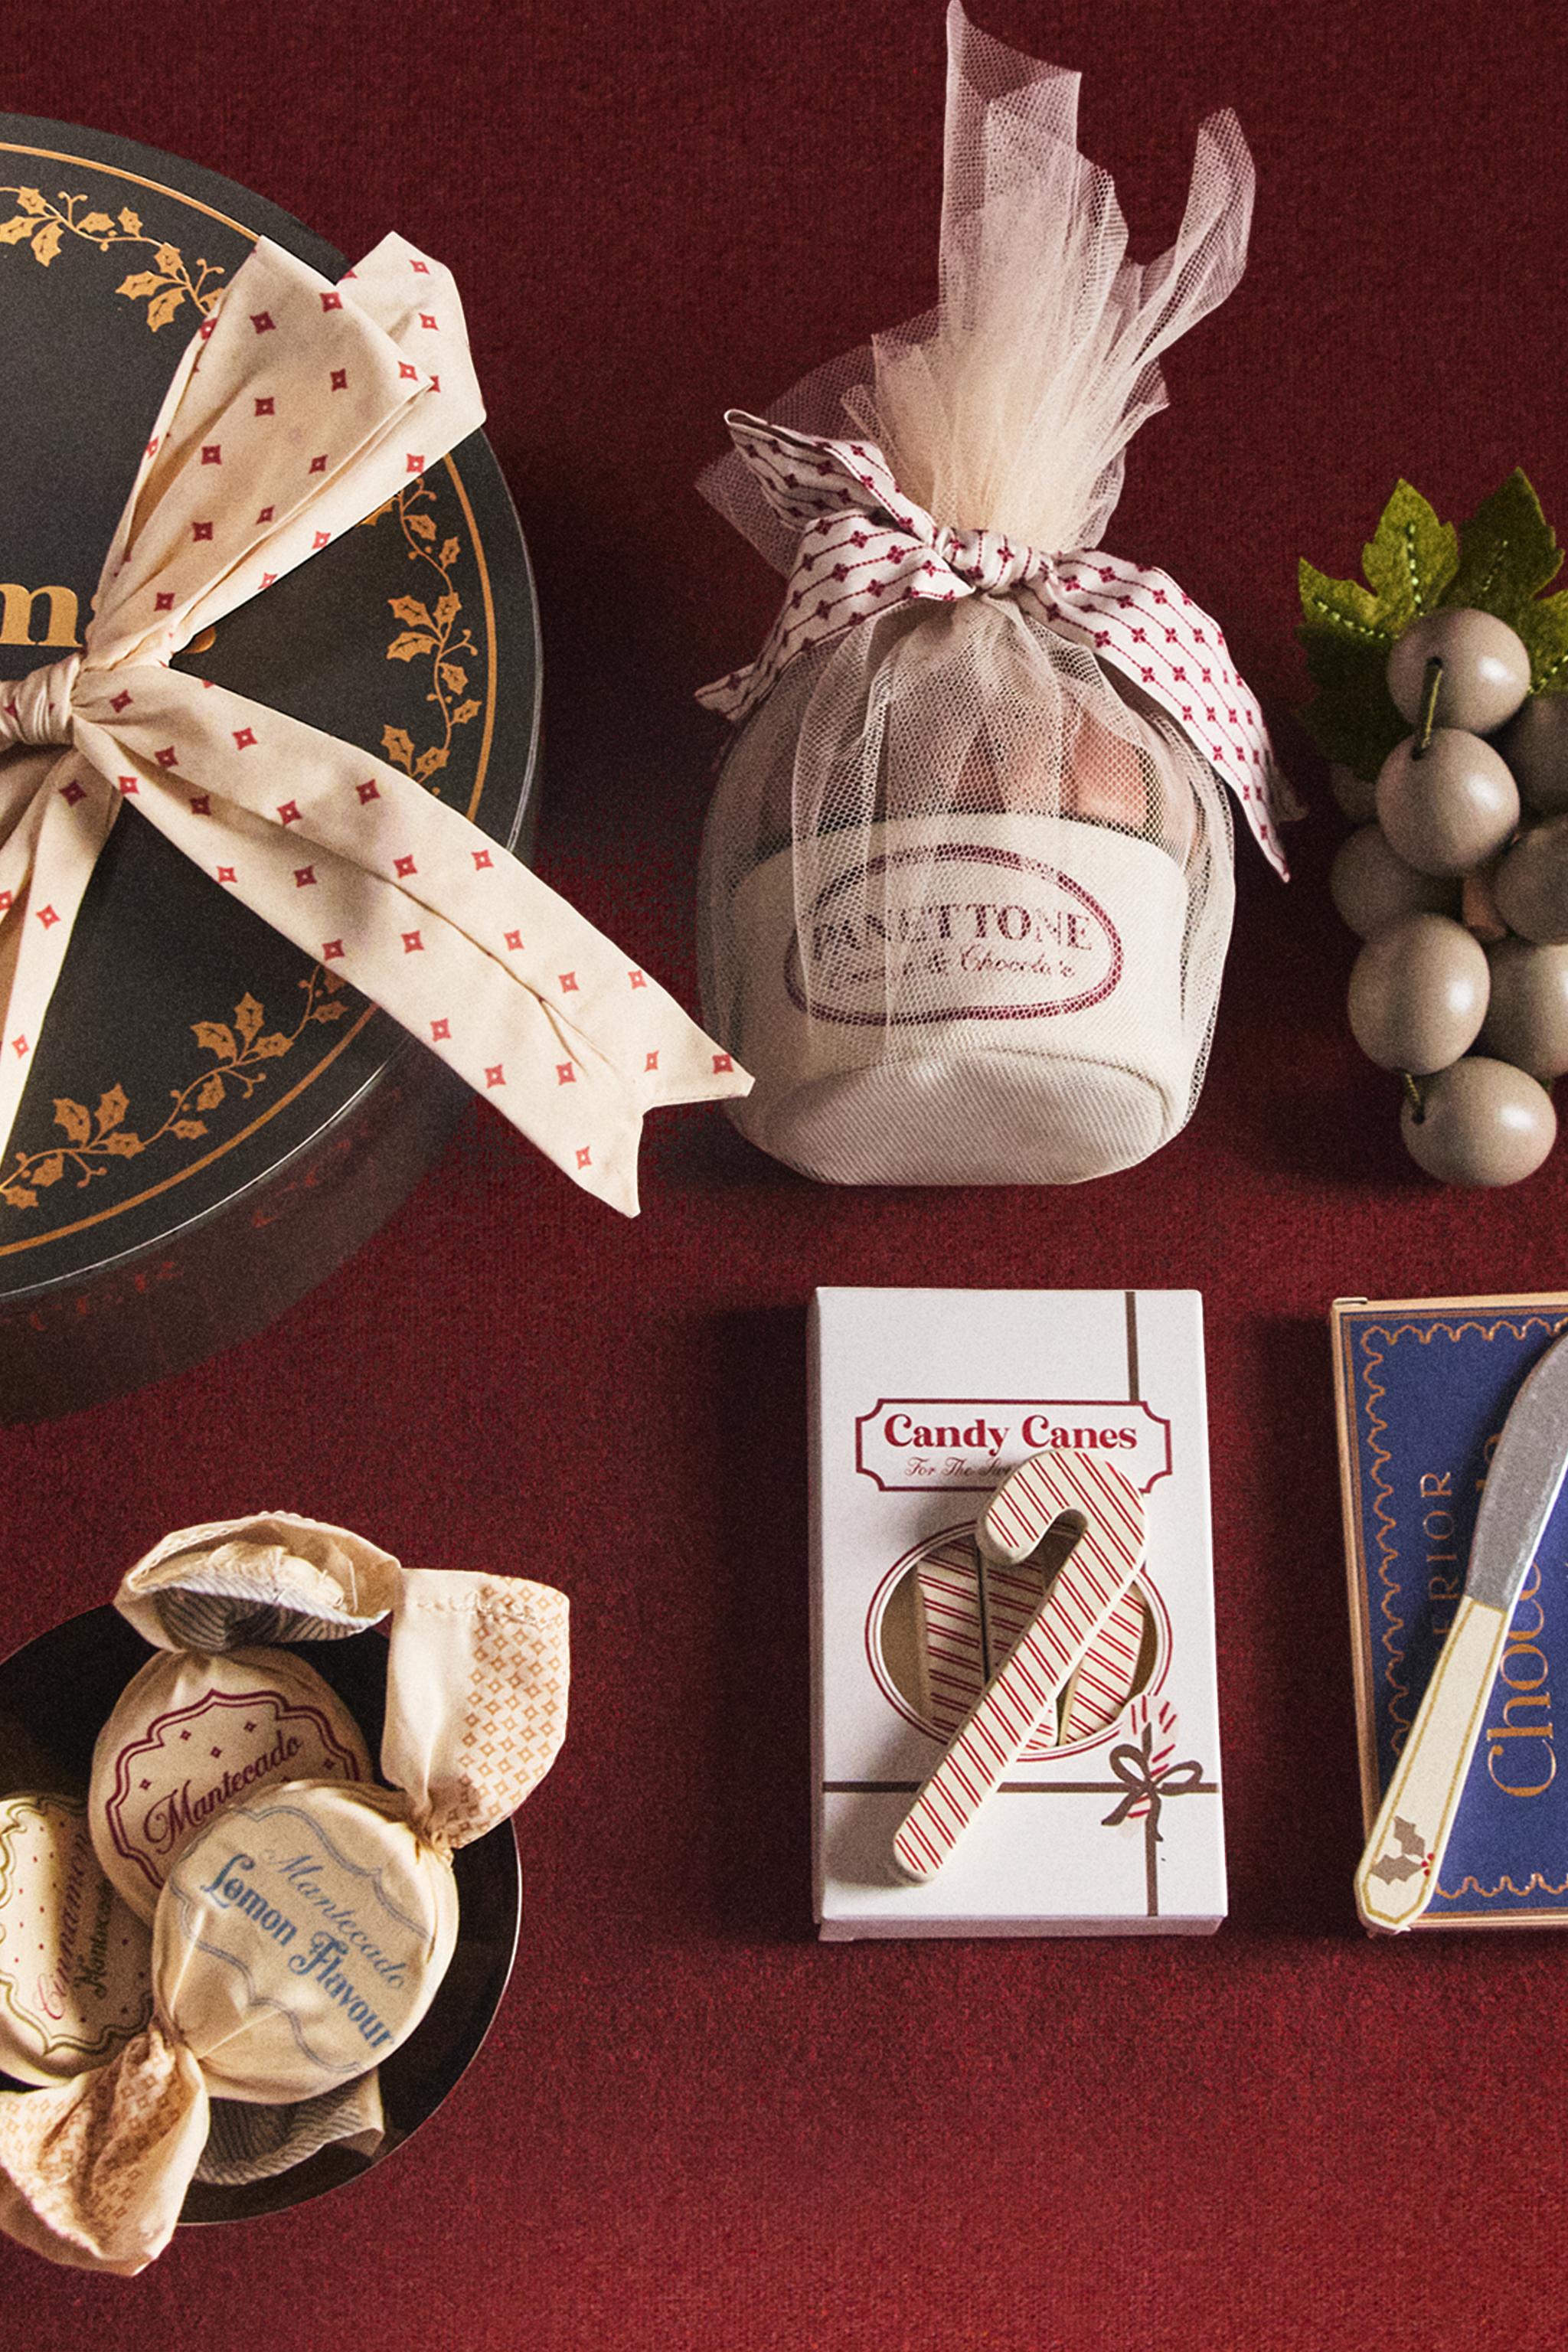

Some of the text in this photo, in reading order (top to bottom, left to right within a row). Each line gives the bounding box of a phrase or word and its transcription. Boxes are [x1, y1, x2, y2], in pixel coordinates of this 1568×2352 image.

[884, 1413, 1138, 1455] Candy Canes
[904, 1456, 1013, 1476] For The Swe
[1420, 1472, 1460, 1635] ERIOR
[144, 1730, 302, 1854] Mantecado
[35, 1834, 90, 2020] Cinnamon
[201, 1854, 394, 2048] Lemon Flavour
[263, 1849, 406, 1989] Mantecado
